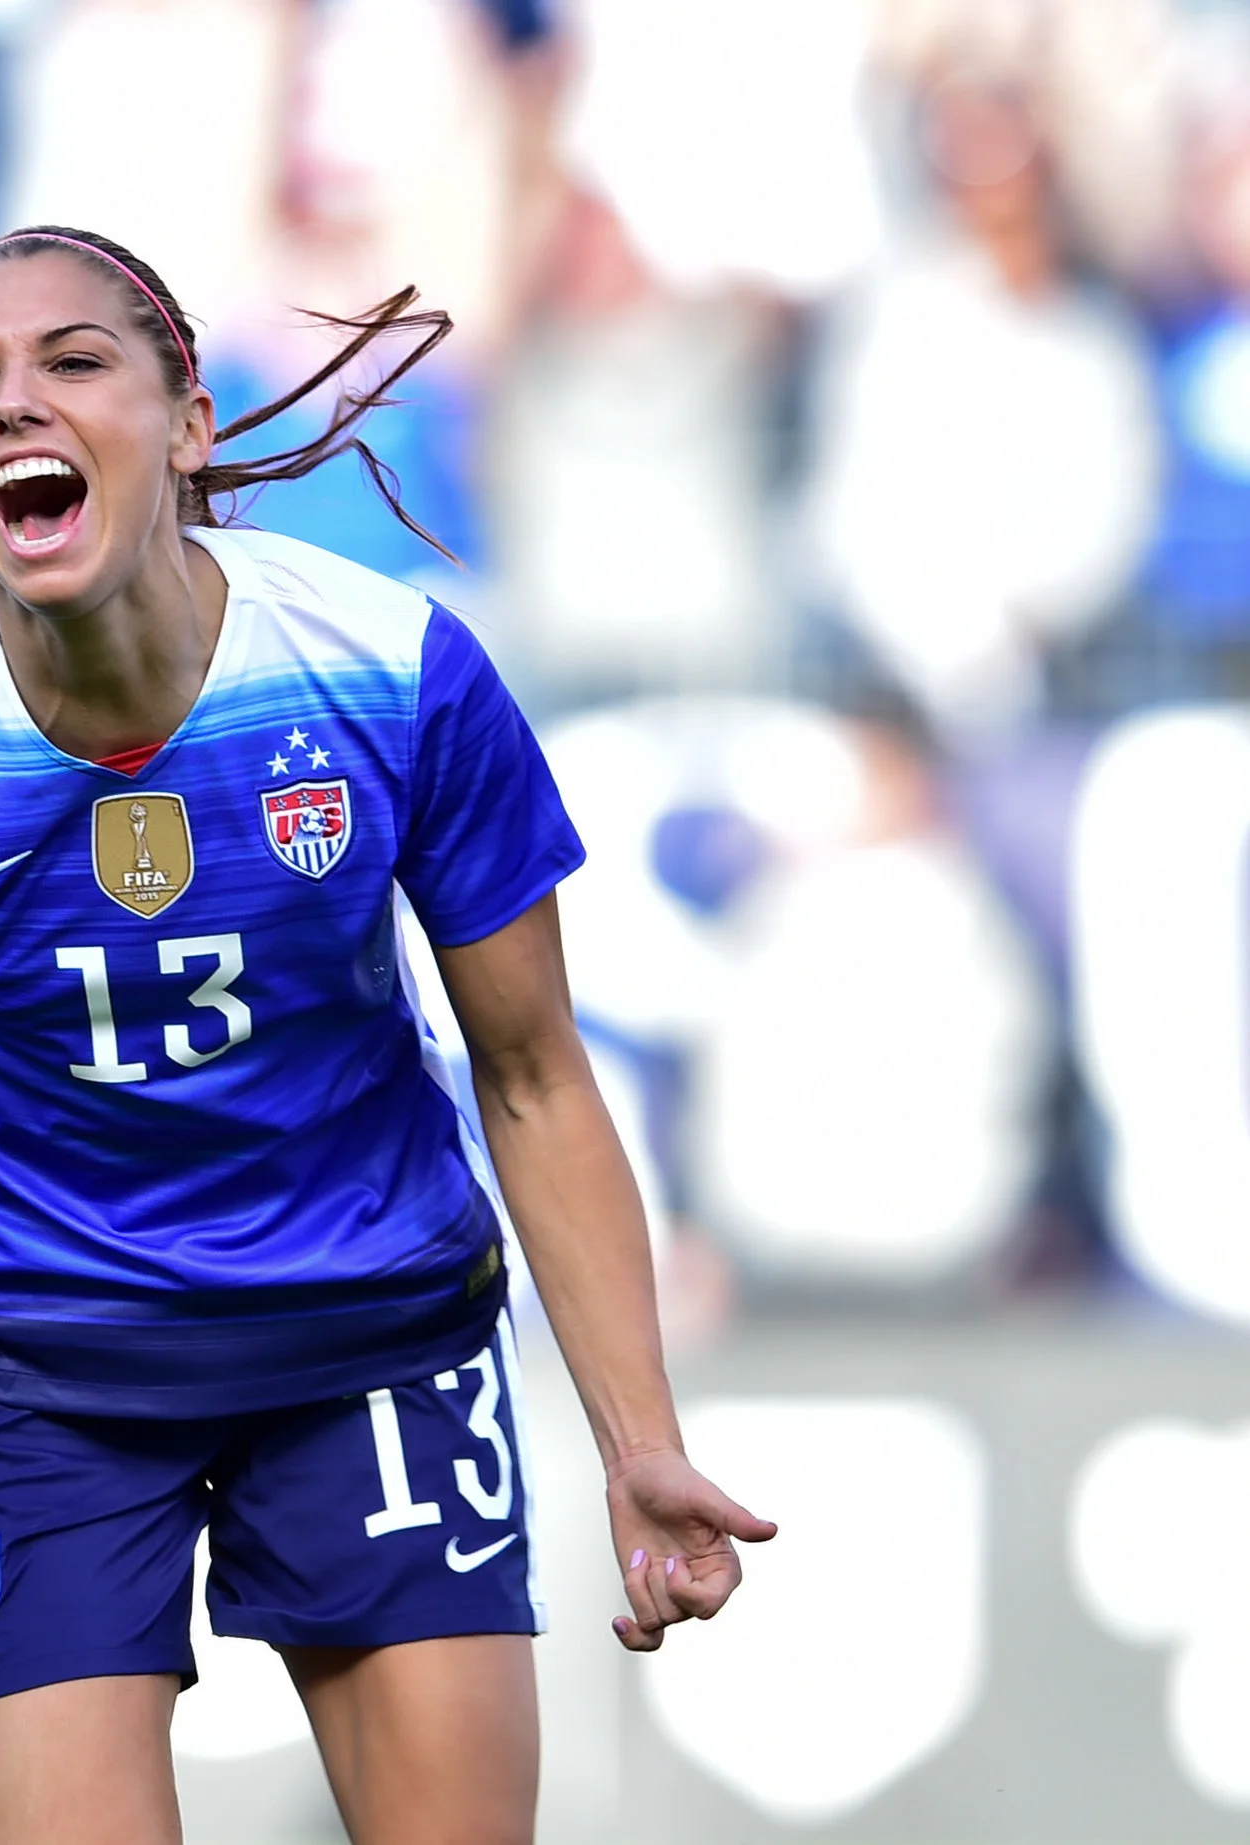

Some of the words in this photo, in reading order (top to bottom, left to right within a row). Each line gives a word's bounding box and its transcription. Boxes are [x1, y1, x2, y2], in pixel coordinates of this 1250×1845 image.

[123, 871, 167, 887] FIFA
[134, 892, 159, 901] 2015
[55, 932, 252, 1083] 13
[363, 1346, 513, 1539] 13
